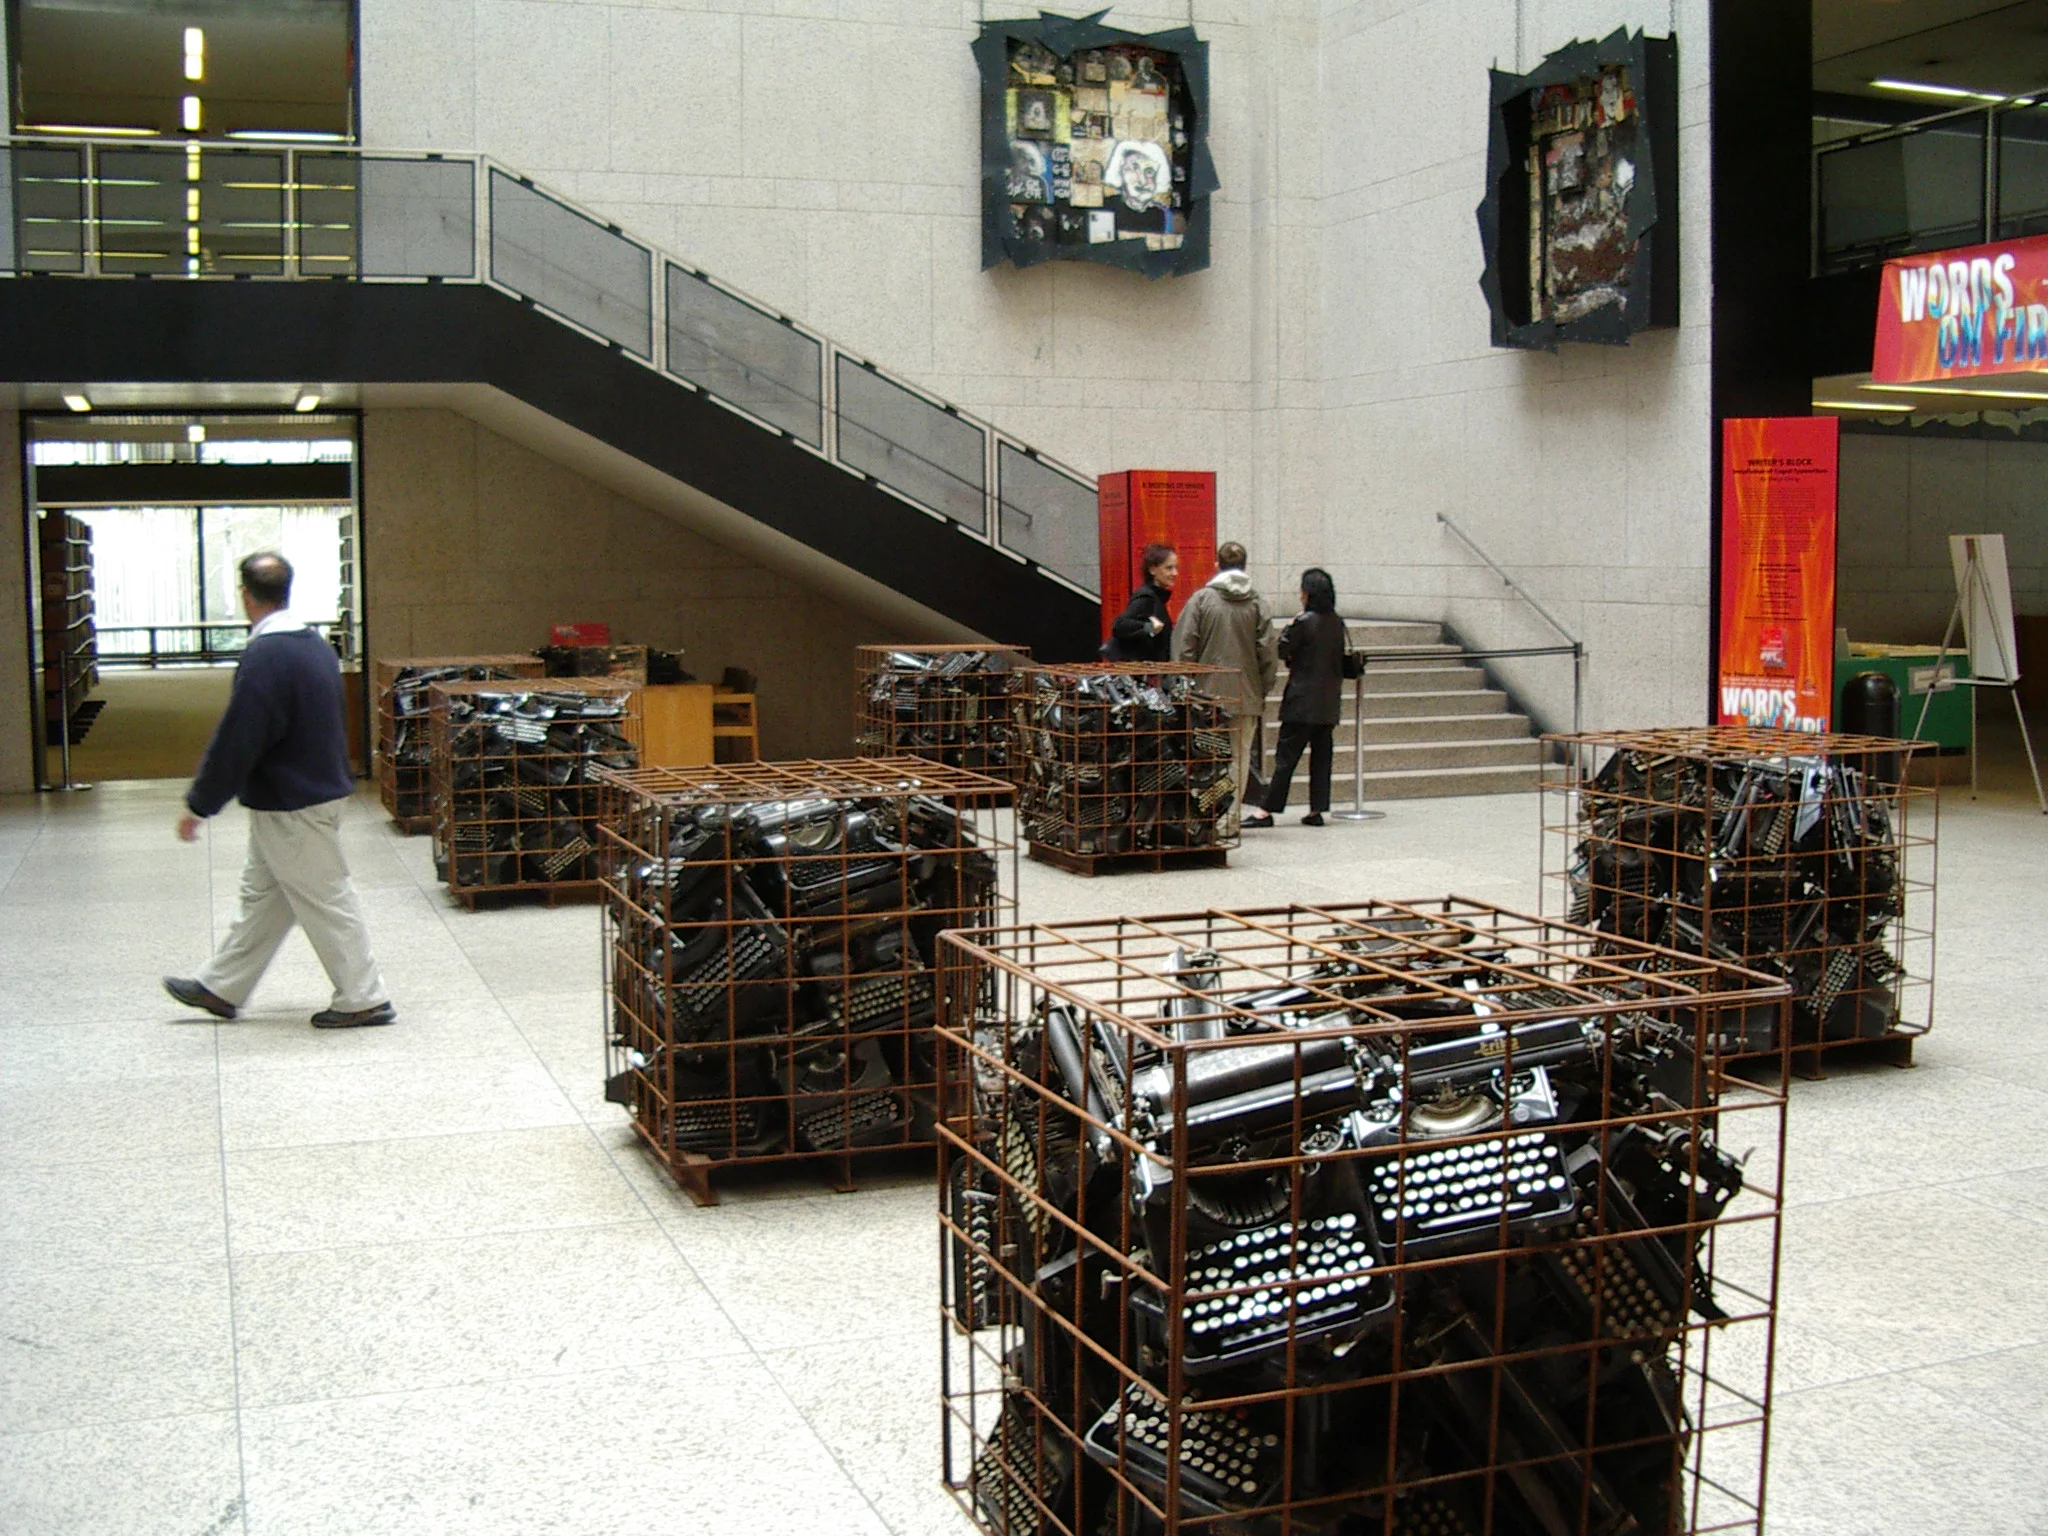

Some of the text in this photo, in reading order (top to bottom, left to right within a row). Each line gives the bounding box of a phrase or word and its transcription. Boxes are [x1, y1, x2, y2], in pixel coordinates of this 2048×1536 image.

[1899, 253, 2015, 323] WORDS
[1938, 304, 1984, 369] ON
[1786, 458, 1812, 467] BLOCK
[1721, 687, 1796, 718] WORDS
